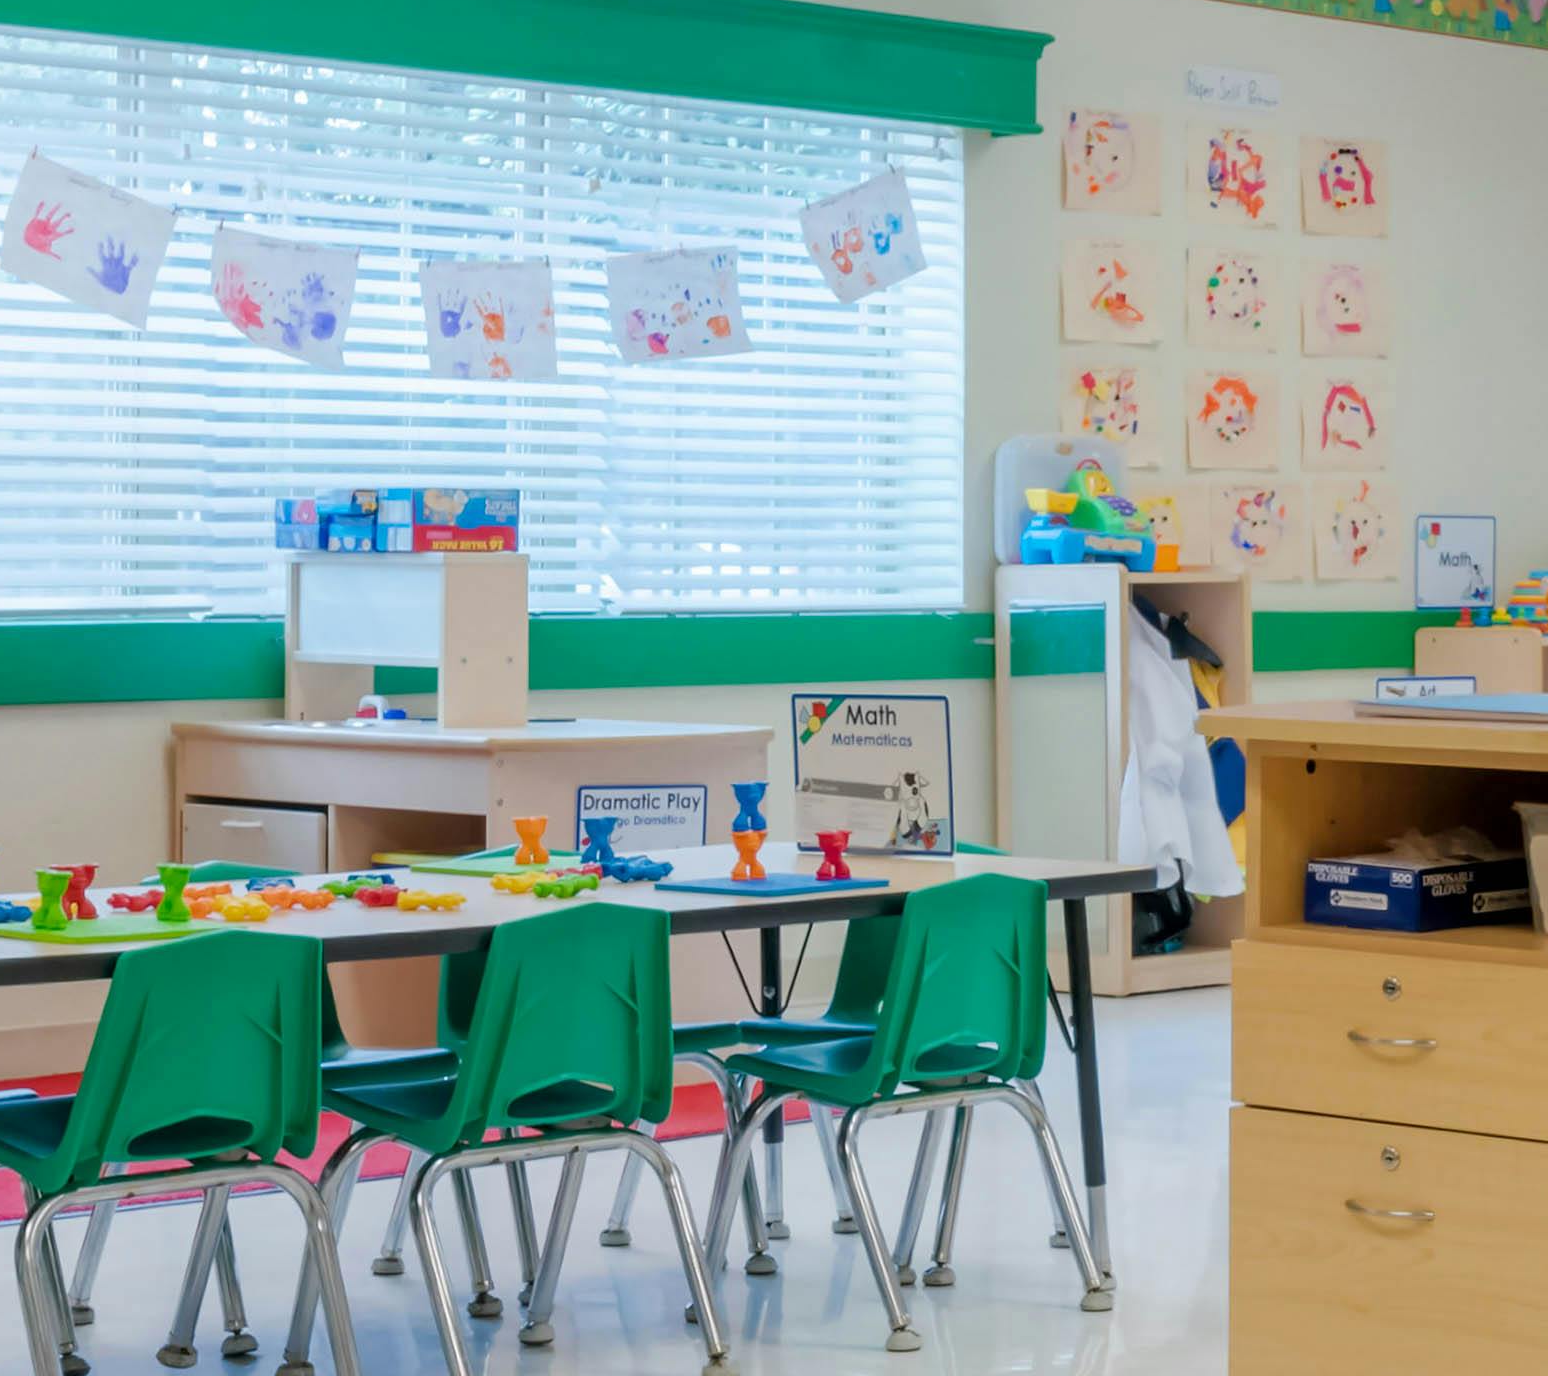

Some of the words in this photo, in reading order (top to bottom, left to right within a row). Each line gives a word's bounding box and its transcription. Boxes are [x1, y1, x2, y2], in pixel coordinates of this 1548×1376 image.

[1438, 552, 1472, 567] Math
[1420, 685, 1436, 697] Art
[846, 704, 898, 726] Math
[583, 792, 660, 810] Dramatic
[667, 792, 702, 812] Play
[1308, 863, 1358, 877] DISPOSABLE
[1316, 872, 1350, 884] GLOVES
[1392, 872, 1412, 884] 500
[1422, 872, 1474, 887] DISPOSABLE
[1432, 884, 1468, 896] GLOVES
